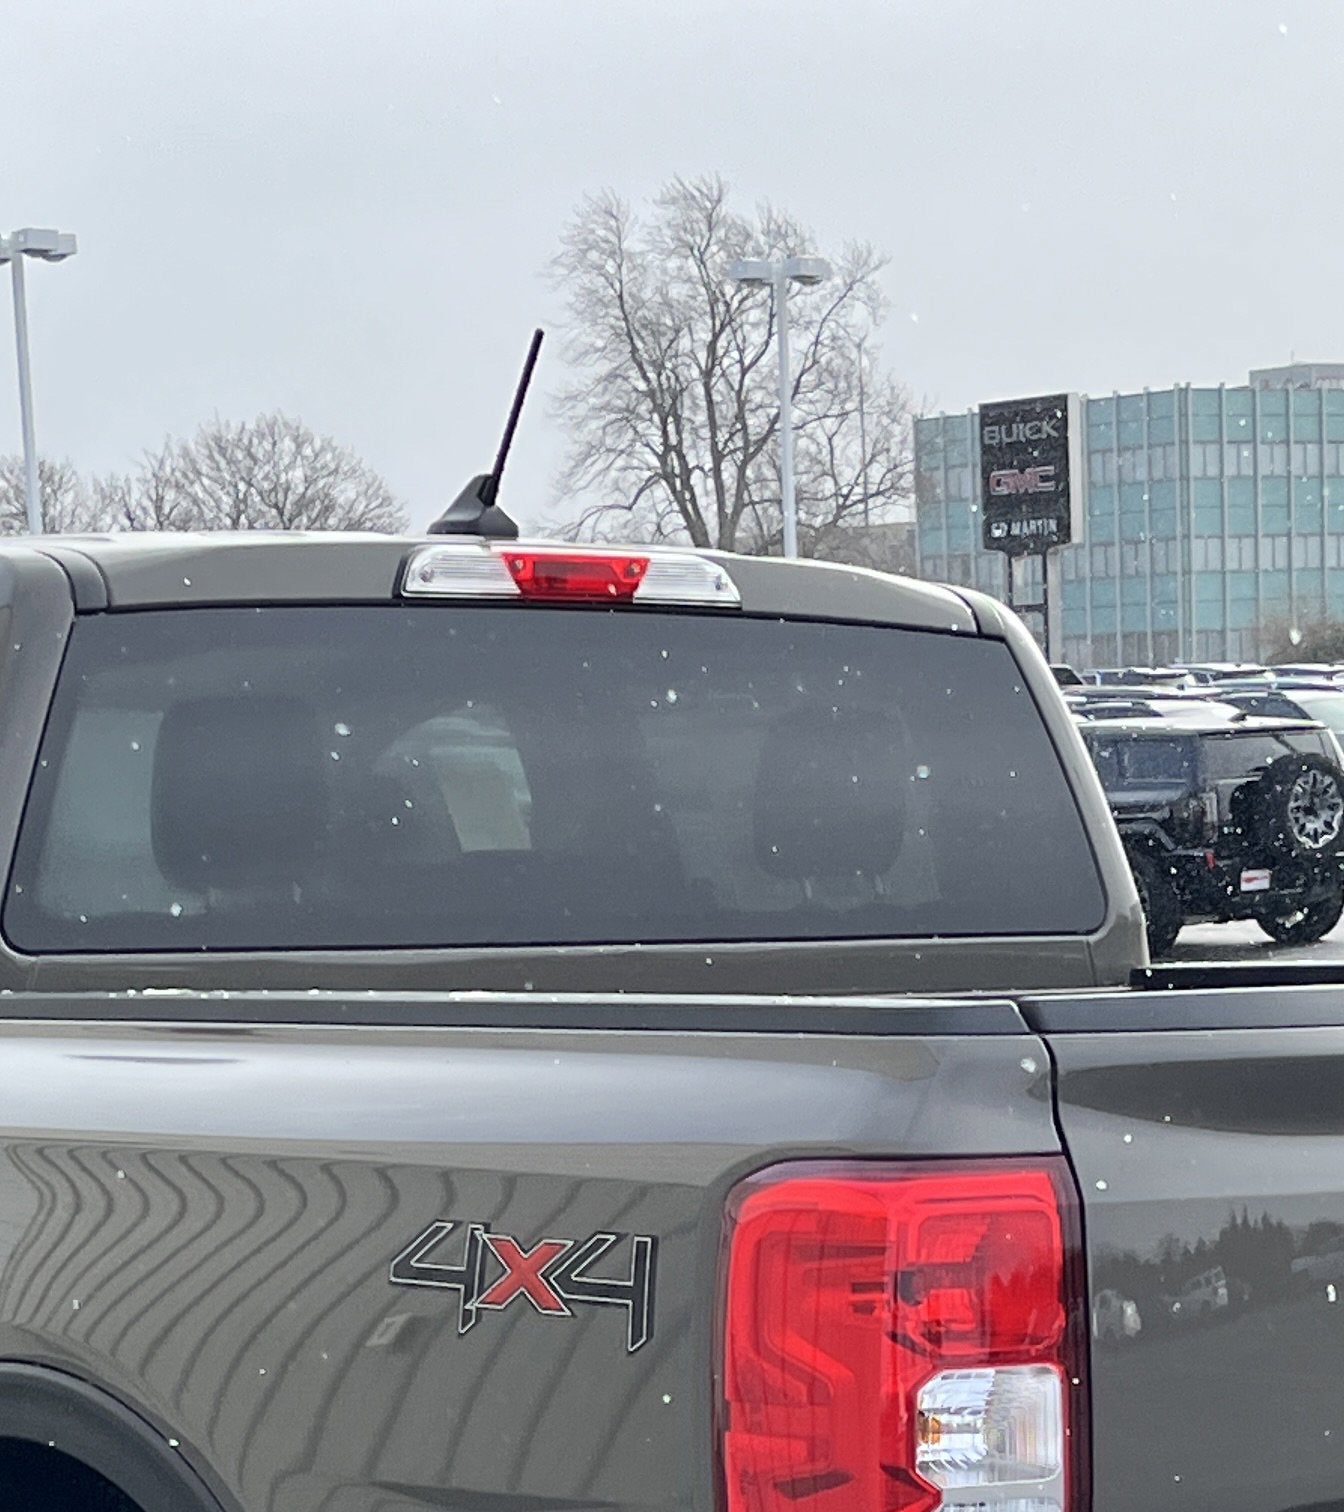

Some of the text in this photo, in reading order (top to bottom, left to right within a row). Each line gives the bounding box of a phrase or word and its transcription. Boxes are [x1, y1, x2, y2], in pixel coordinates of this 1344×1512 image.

[983, 419, 1059, 446] BUICK
[989, 466, 1056, 496] GMC
[1010, 518, 1058, 537] MARTIN
